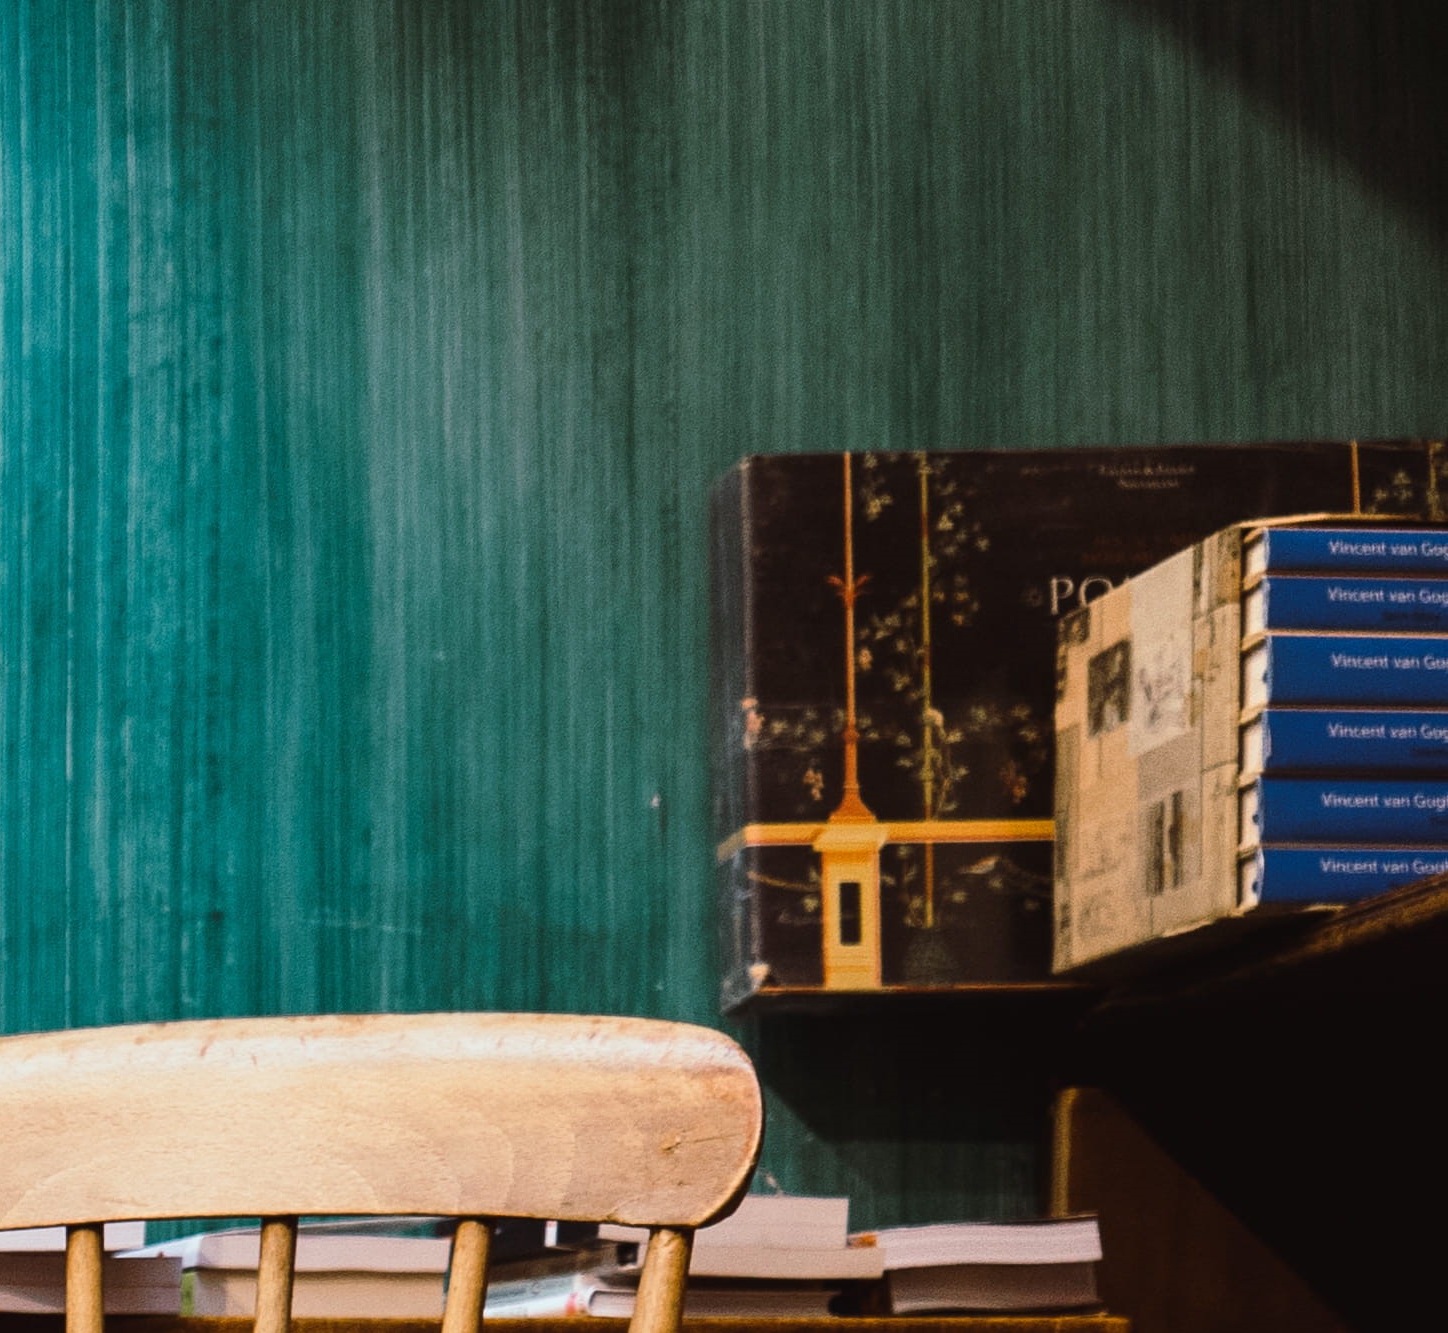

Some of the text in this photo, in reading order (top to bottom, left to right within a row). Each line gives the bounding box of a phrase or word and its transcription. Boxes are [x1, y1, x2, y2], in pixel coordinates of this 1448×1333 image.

[1327, 586, 1385, 603] Vincent
[1389, 590, 1415, 603] van
[1321, 793, 1379, 808] Vincent
[1383, 796, 1410, 808] van
